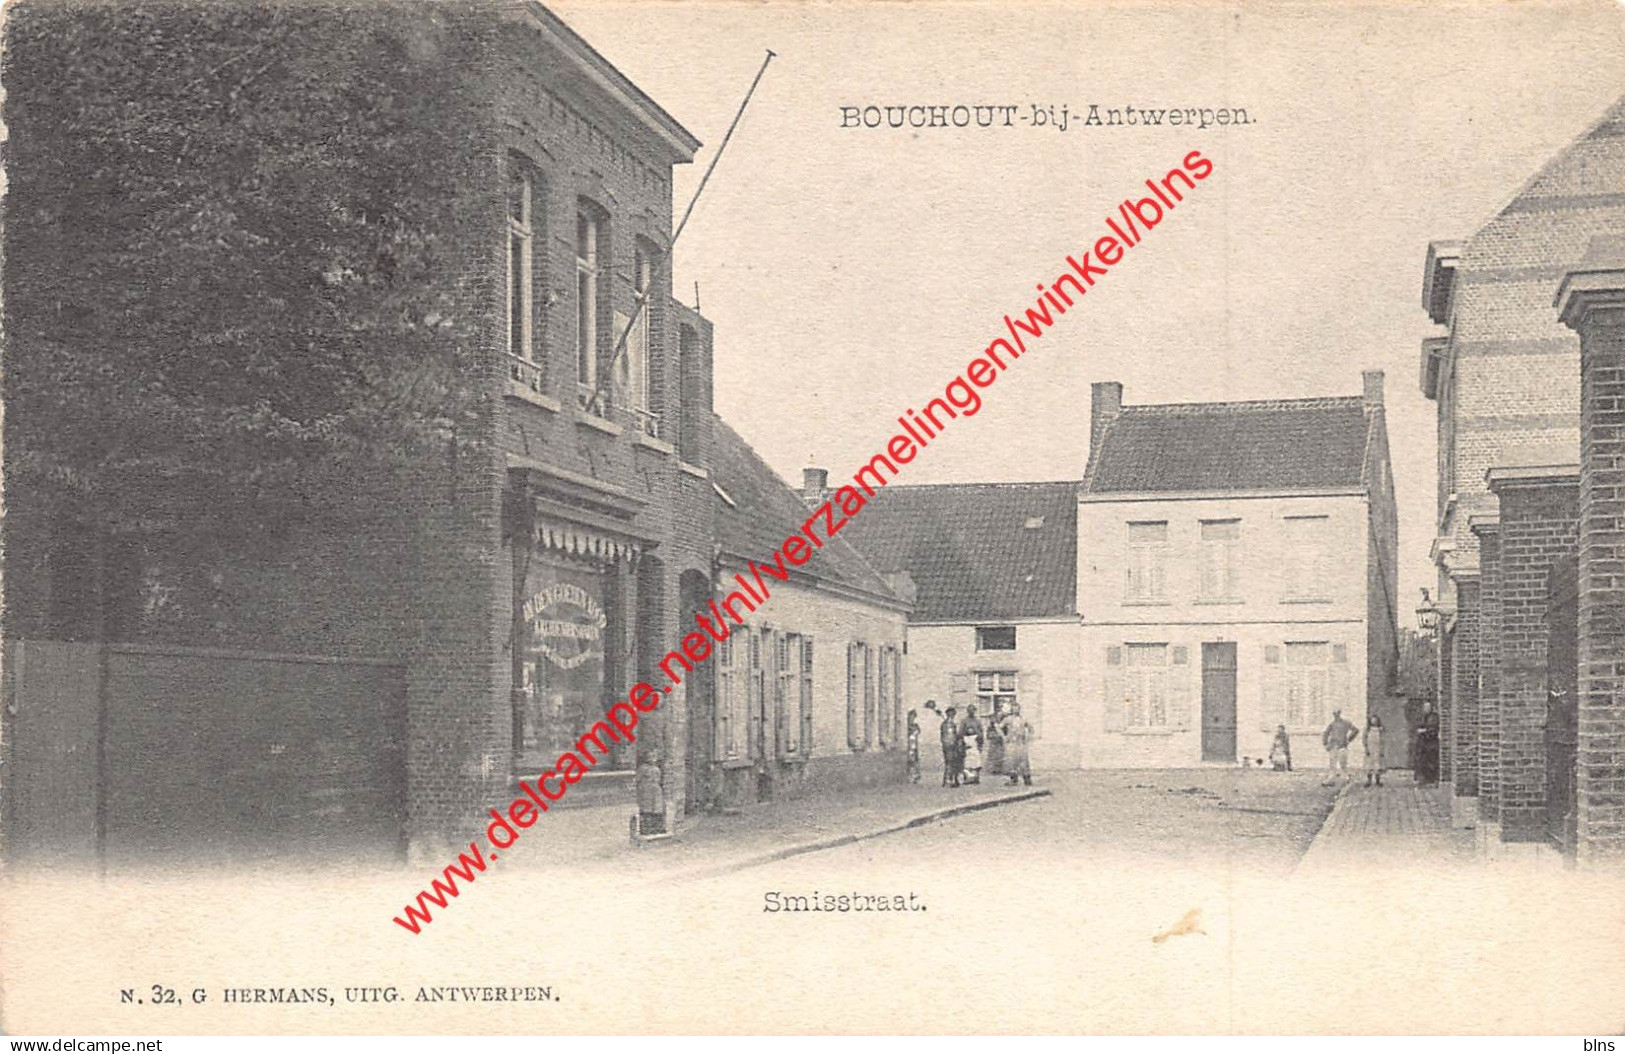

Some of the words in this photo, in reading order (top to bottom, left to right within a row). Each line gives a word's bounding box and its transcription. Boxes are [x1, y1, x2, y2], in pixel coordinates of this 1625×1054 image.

[839, 104, 1257, 132] BOUCHOUT-bij-Antwerpen.
[763, 891, 927, 913] Smisstraat.
[120, 988, 143, 1005] N.
[150, 984, 182, 1006] 32,
[223, 988, 335, 1007] HERMANS,
[415, 987, 560, 1004] ANTWERPEN.
